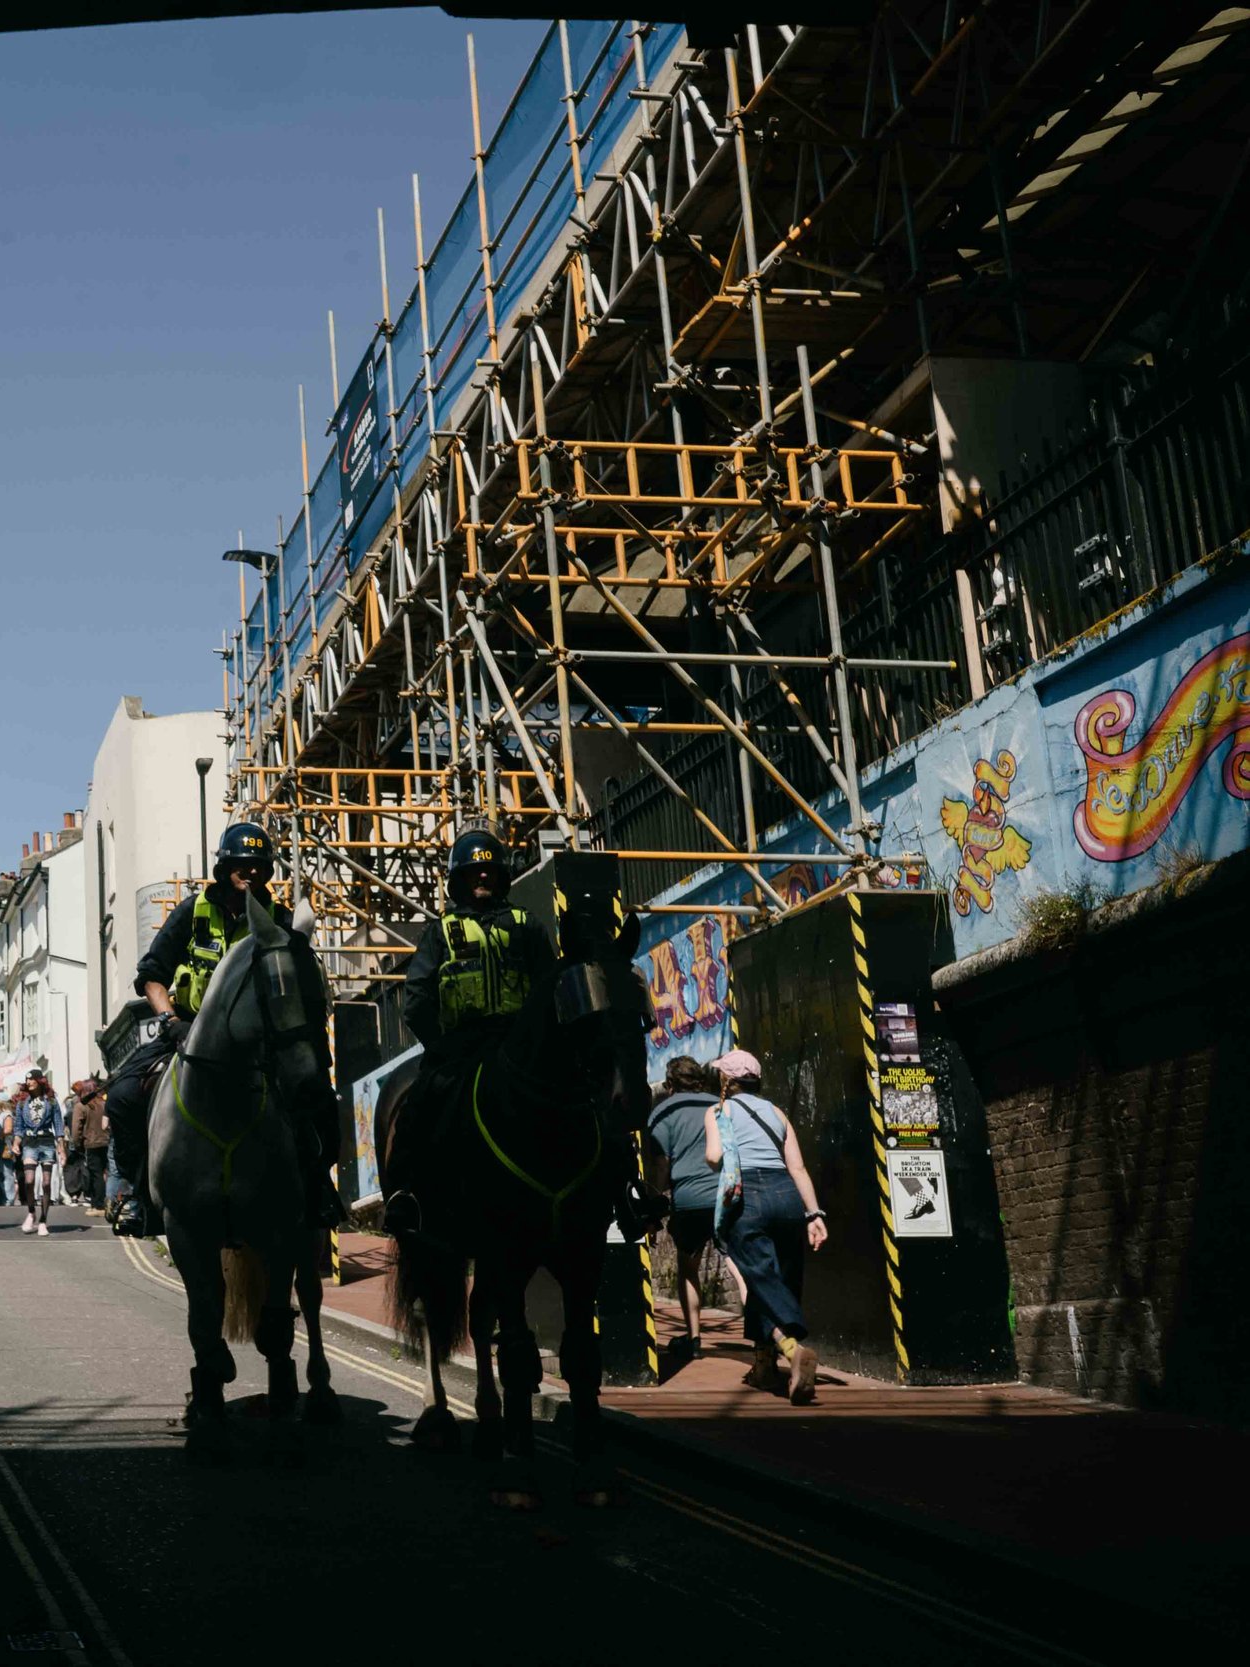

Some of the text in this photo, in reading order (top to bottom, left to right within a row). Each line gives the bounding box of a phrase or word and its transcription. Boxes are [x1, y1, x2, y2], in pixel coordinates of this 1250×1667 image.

[472, 850, 493, 861] 410
[887, 1067, 926, 1076] THE VOLKS
[880, 1075, 935, 1084] 30TH BIRTHDAY
